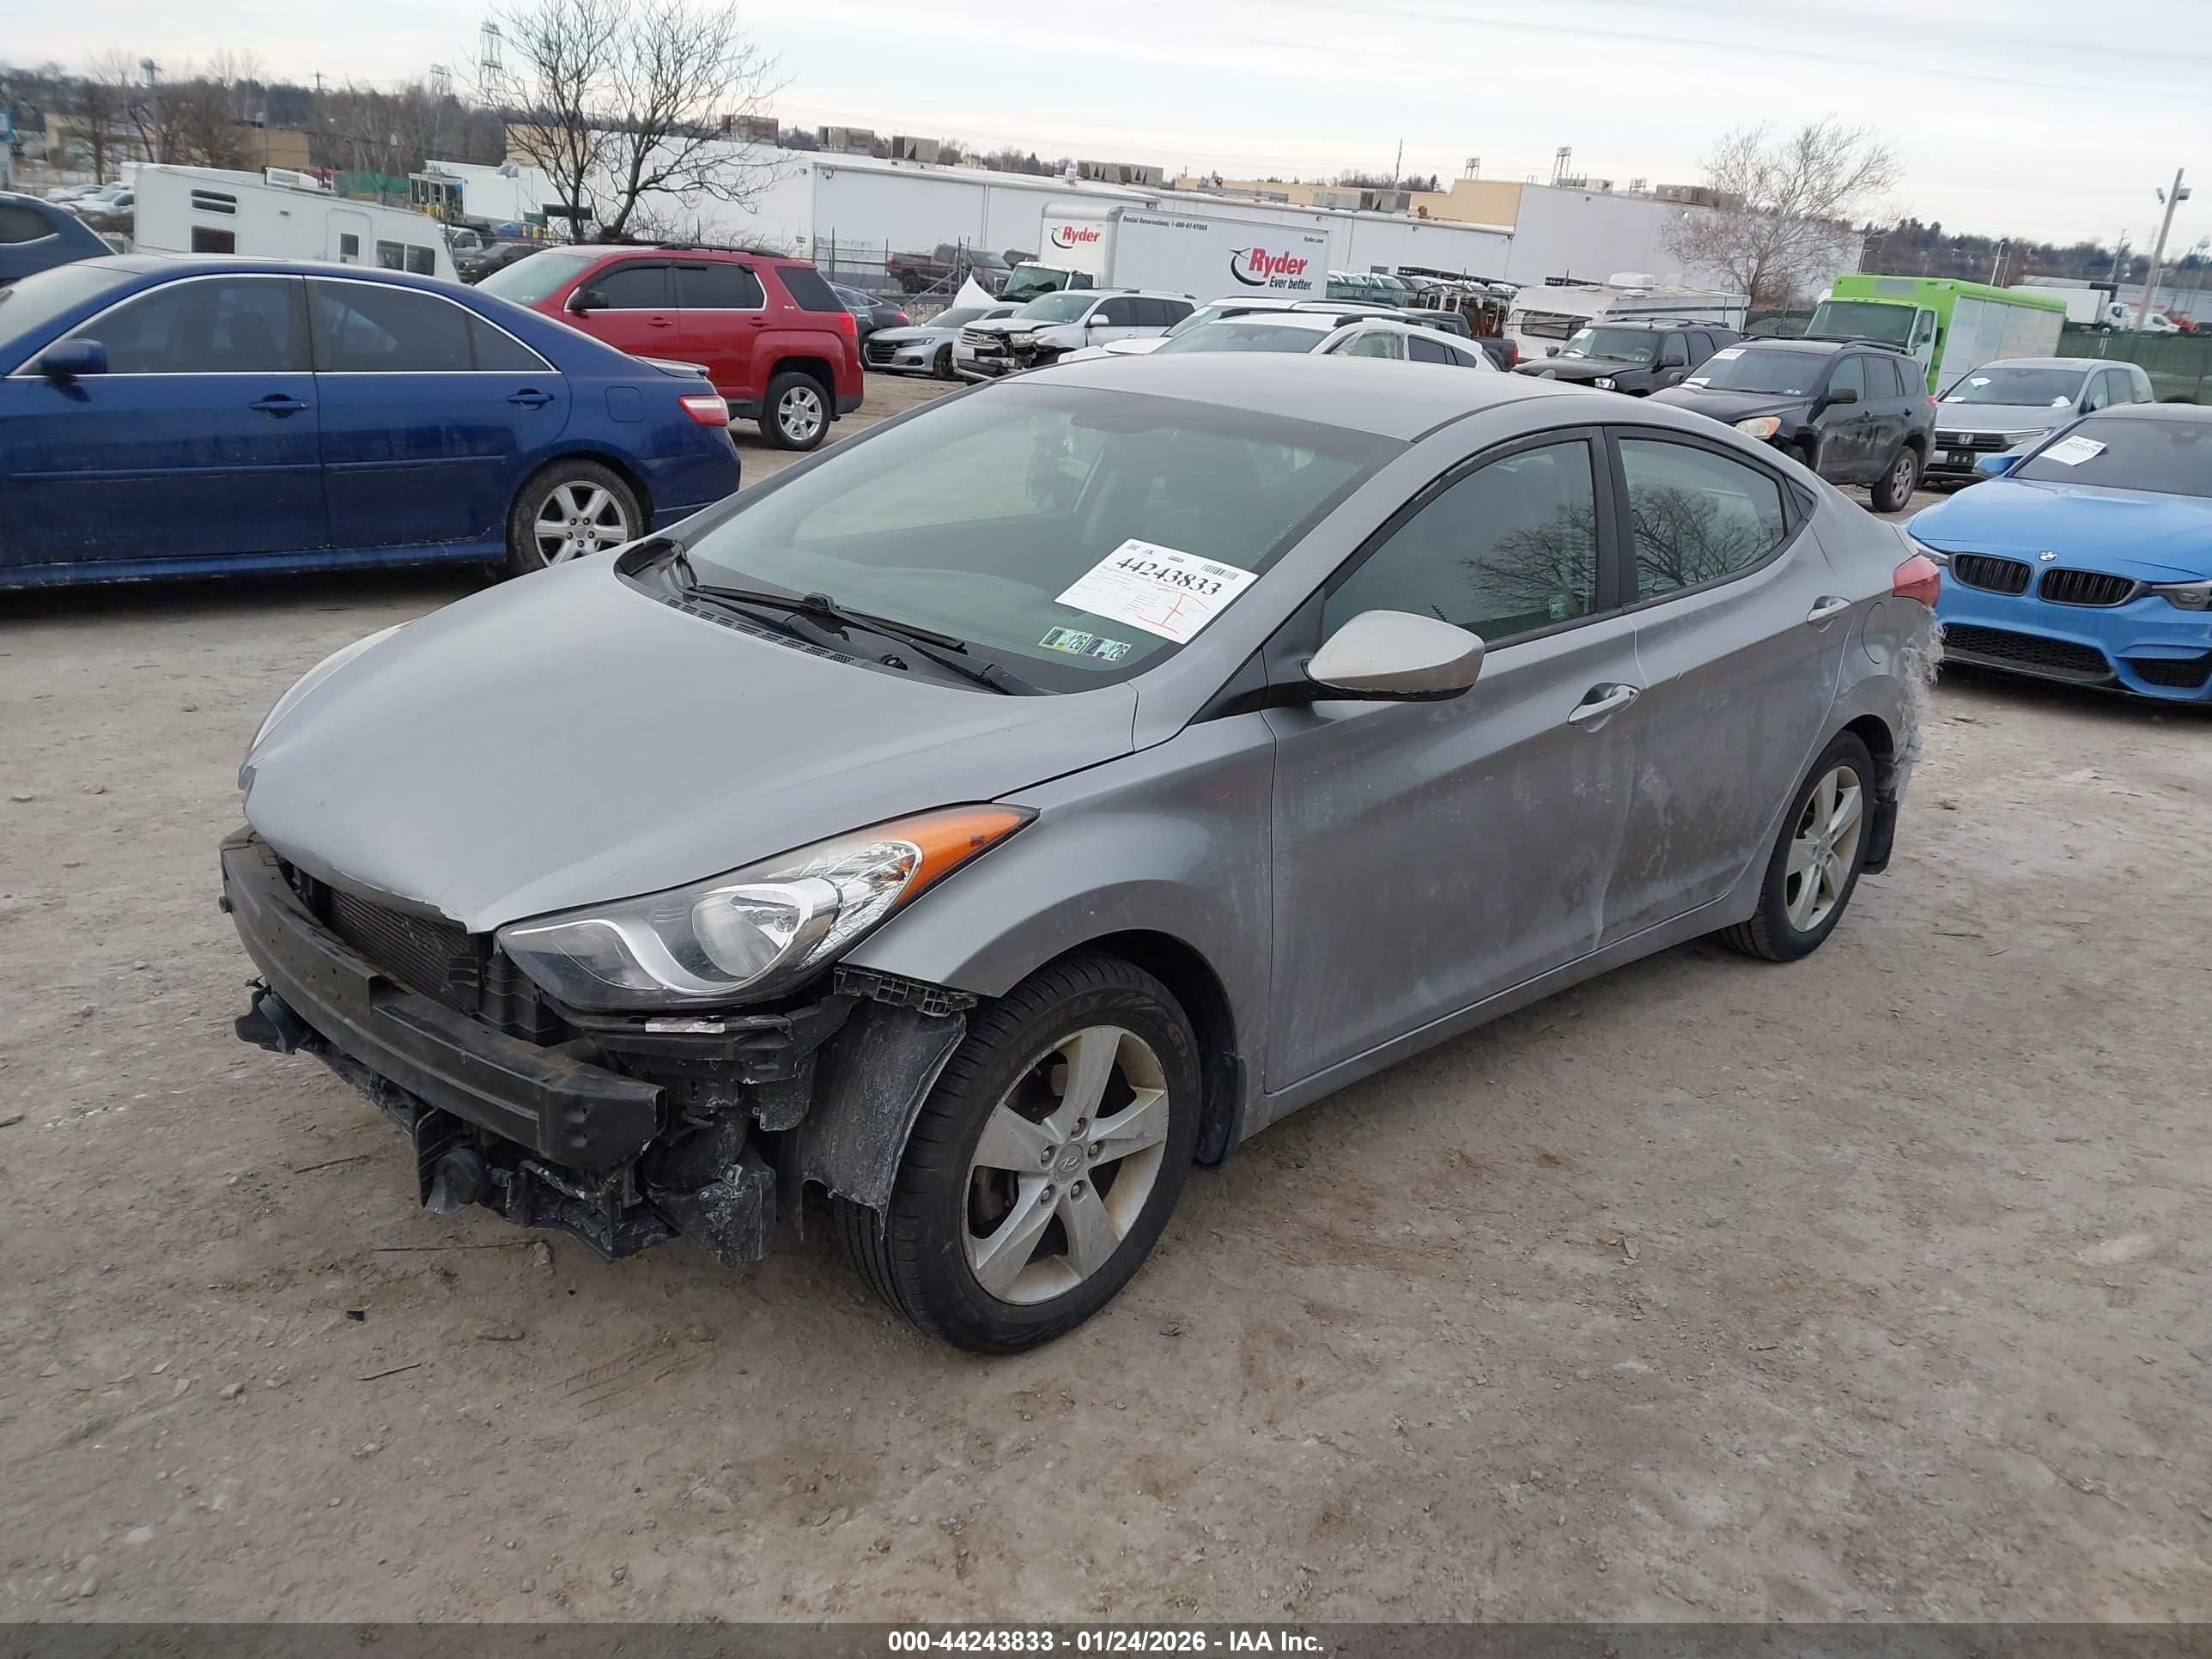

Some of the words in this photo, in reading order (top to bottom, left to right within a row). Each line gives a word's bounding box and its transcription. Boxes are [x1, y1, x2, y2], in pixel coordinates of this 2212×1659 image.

[1062, 226, 1100, 244] Ryder
[1249, 247, 1308, 278] Ryder
[1269, 276, 1288, 289] Ever
[1288, 277, 1311, 290] better.
[1116, 557, 1222, 595] 44243833
[1049, 629, 1065, 646] 2
[1087, 638, 1103, 654] 2
